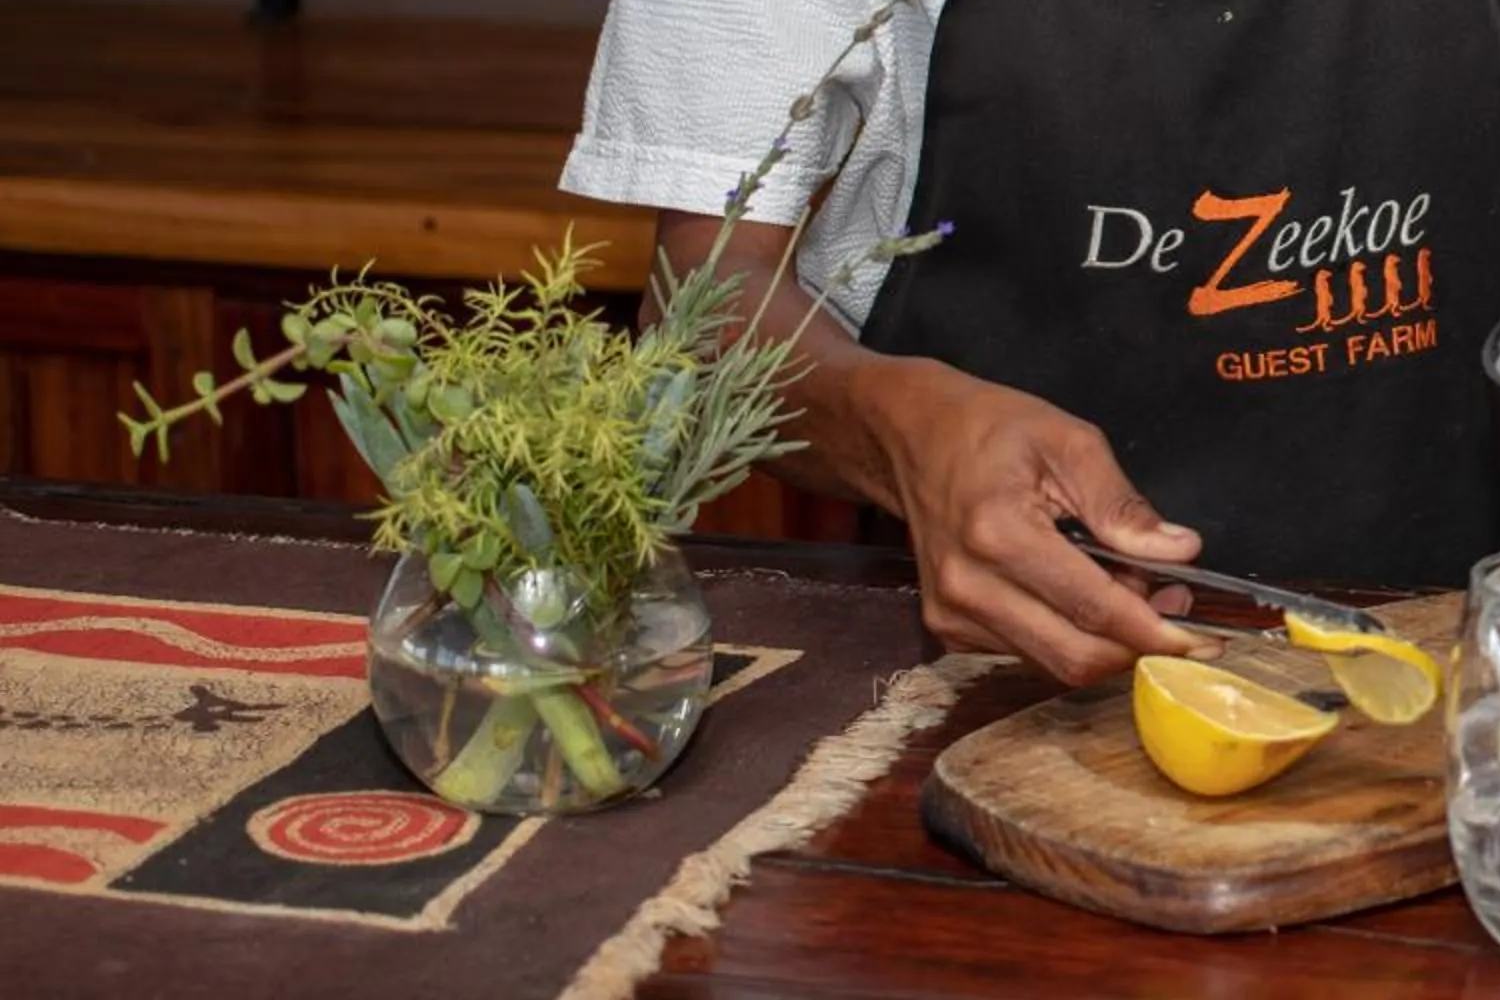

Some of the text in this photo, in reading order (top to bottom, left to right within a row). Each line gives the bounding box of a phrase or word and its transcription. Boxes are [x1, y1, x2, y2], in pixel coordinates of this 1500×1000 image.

[1081, 186, 1431, 316] De Zeekoe
[1215, 318, 1439, 381] GUEST FARM
